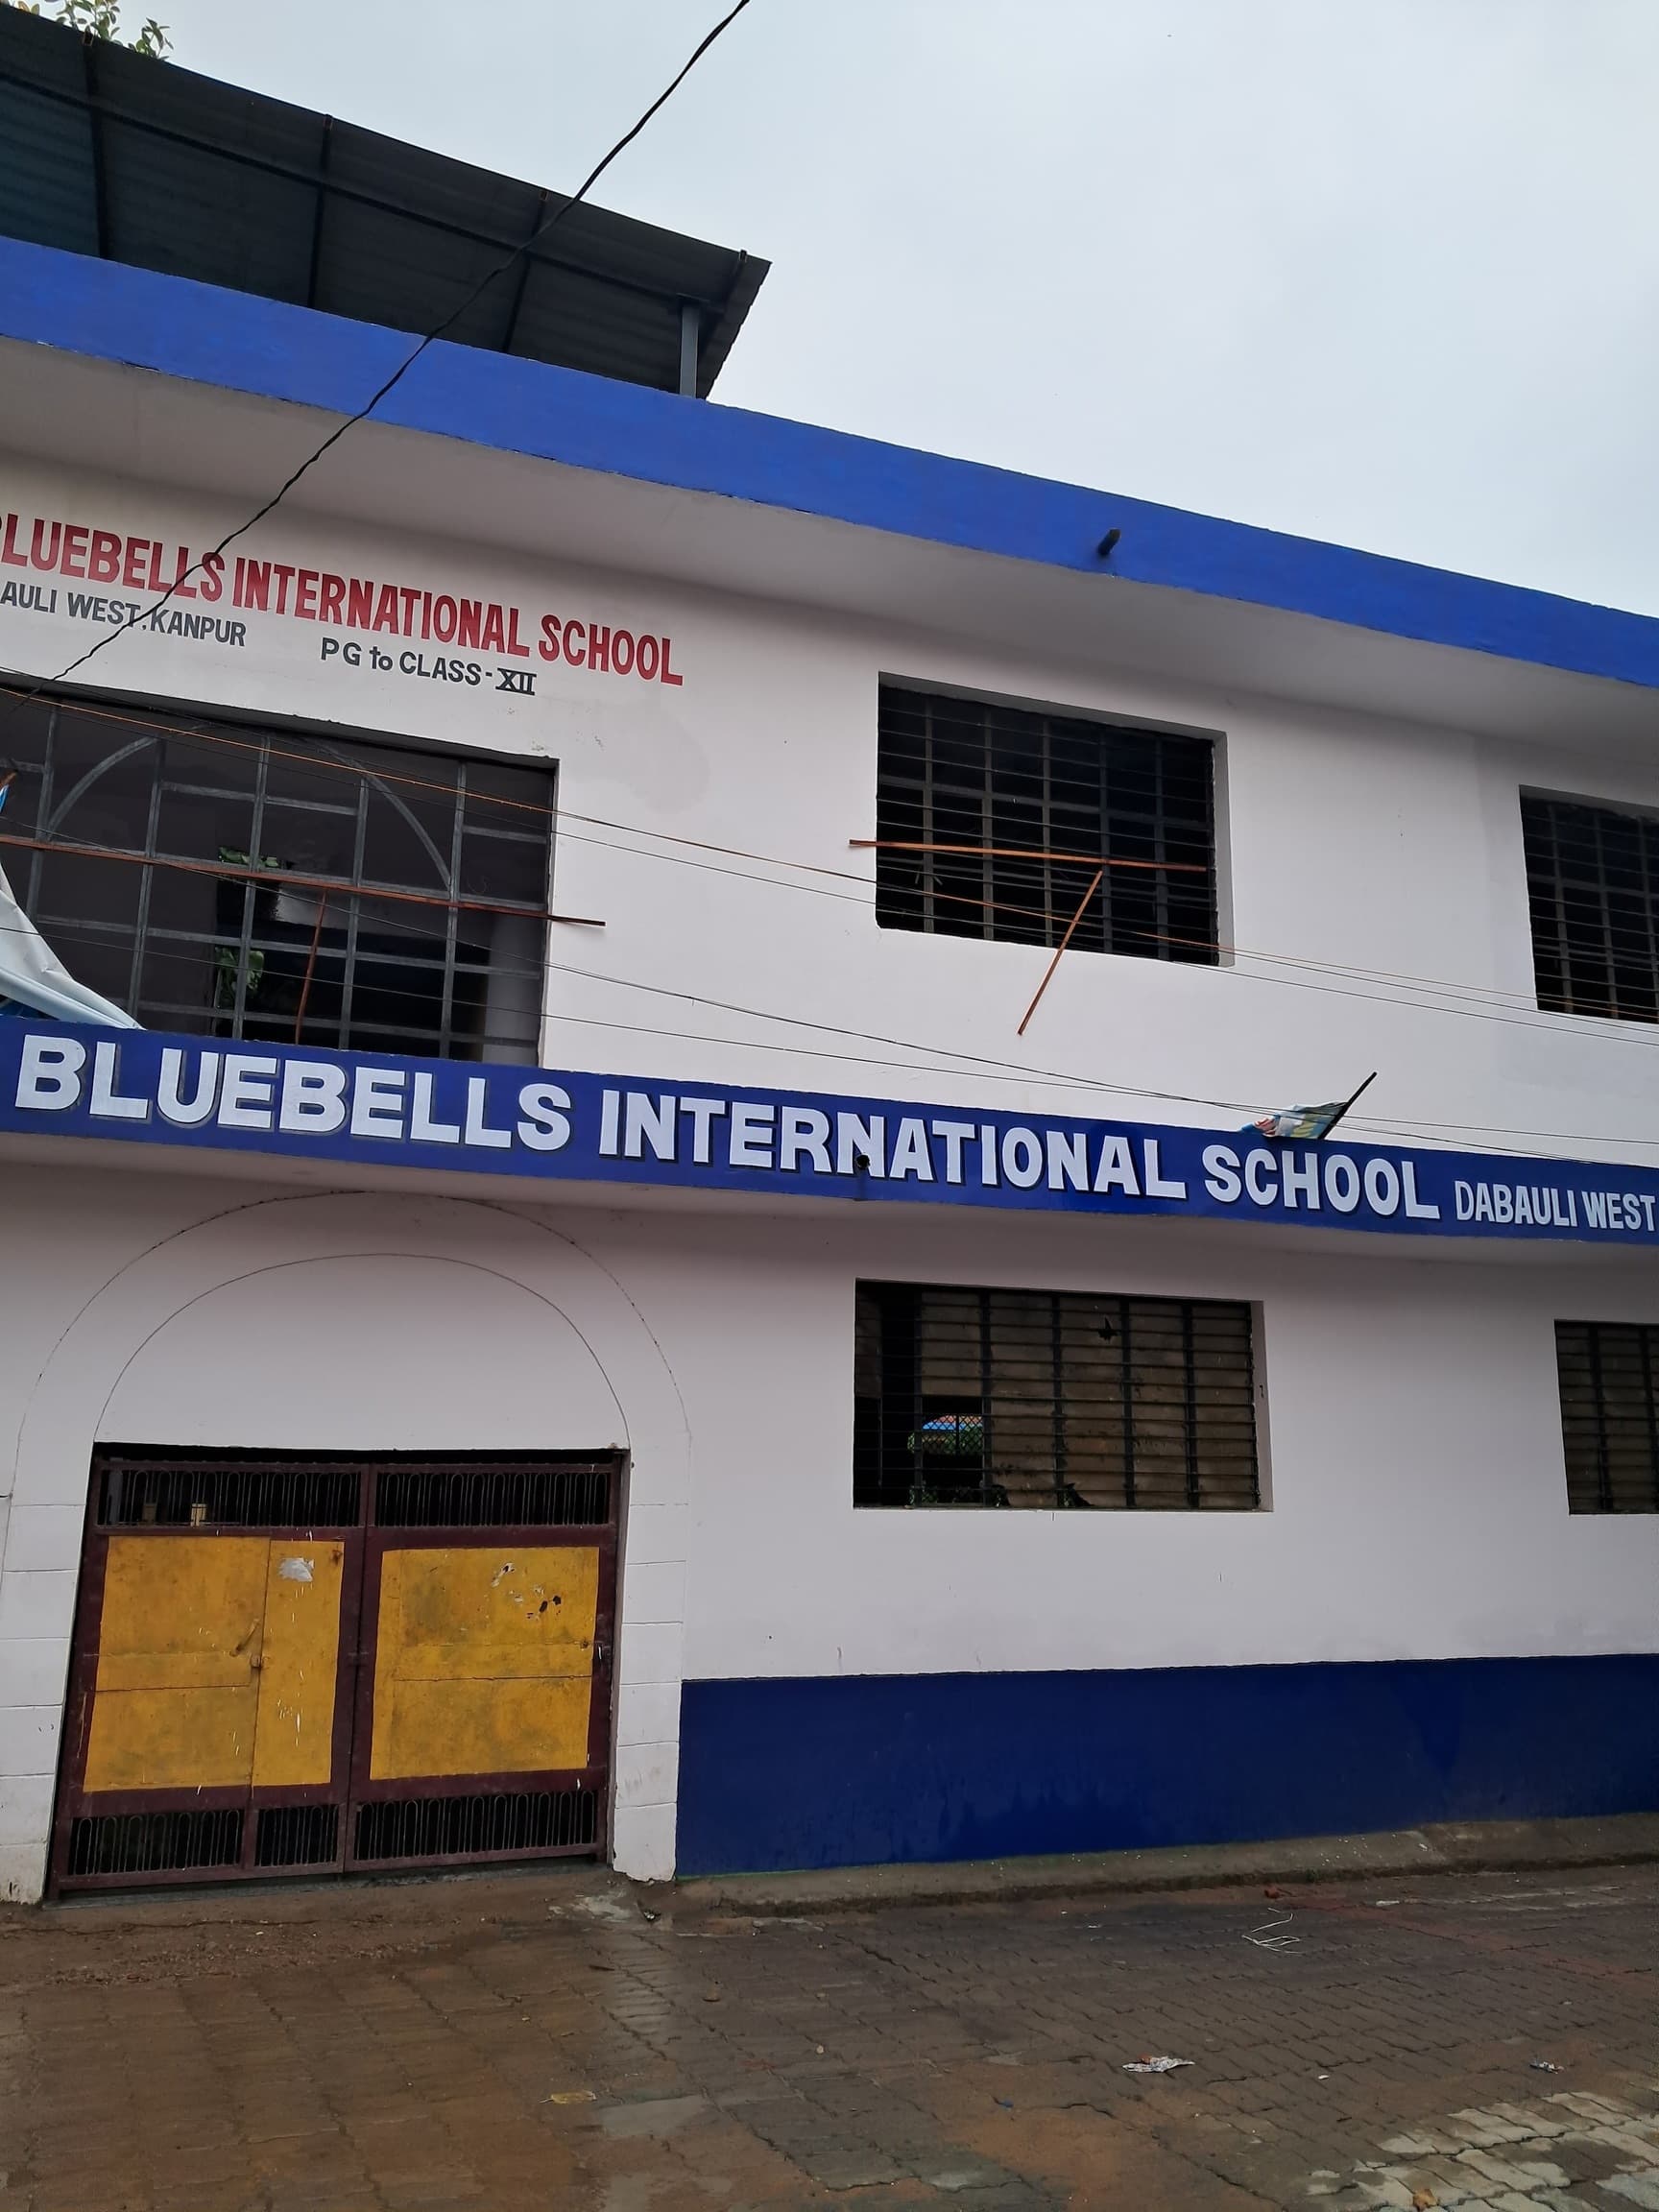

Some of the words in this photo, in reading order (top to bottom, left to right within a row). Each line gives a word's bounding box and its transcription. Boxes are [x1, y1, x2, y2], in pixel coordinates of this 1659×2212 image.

[0, 513, 225, 602] LUEBELLS
[232, 557, 531, 658] INTERNATIONAL
[538, 614, 684, 685] SCHOOL
[321, 637, 362, 666] PG
[370, 645, 394, 671] to
[14, 1034, 572, 1151] BLUEBELLS
[598, 1089, 1187, 1199] INTERNATIONAL
[1202, 1144, 1441, 1220] SCHOOL
[1455, 1180, 1578, 1227] DABAULI
[1581, 1191, 1656, 1232] WEST
